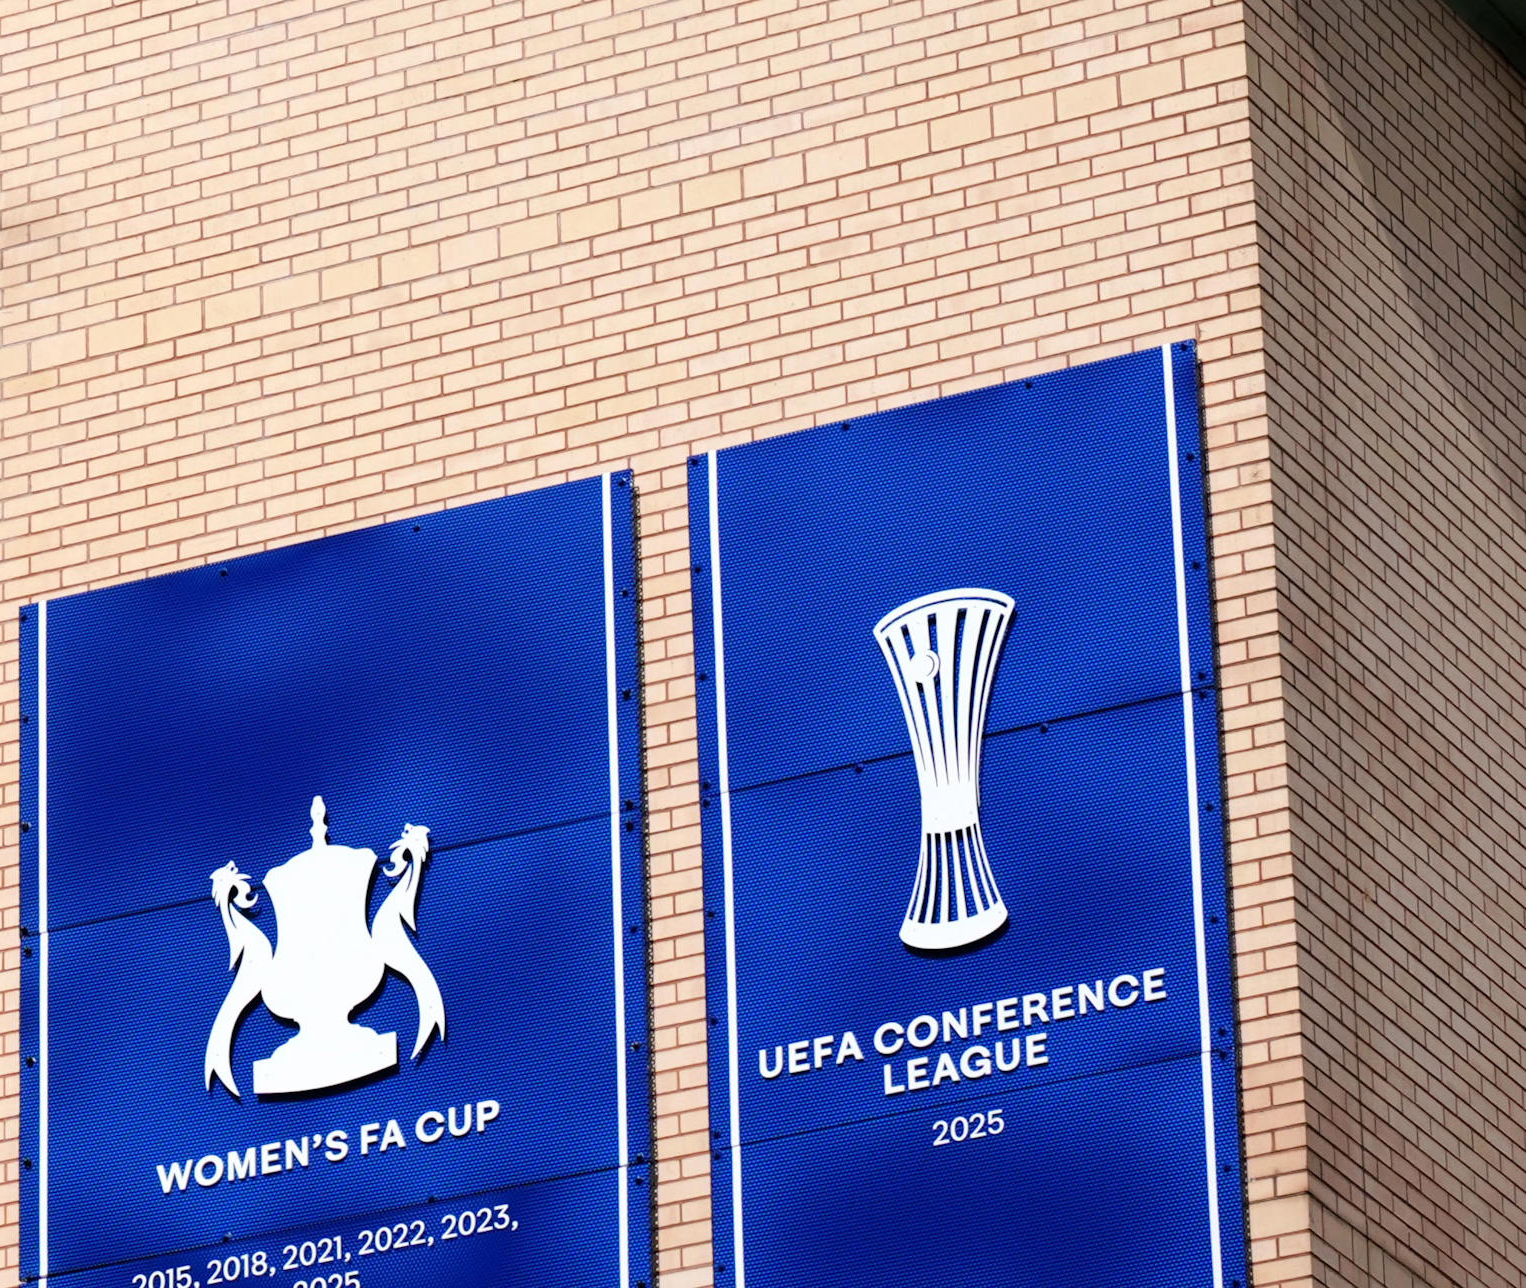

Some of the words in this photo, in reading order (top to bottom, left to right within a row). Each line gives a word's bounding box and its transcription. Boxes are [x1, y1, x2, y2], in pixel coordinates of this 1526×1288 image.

[758, 1032, 865, 1079] UEFA
[873, 967, 1168, 1055] CONFERENCE
[883, 1032, 1049, 1095] LEAGUE
[156, 1129, 349, 1194] WOMEN’S
[360, 1119, 407, 1155] FA
[415, 1099, 500, 1143] CUP
[932, 1108, 1005, 1147] 2025
[206, 1251, 277, 1285] 2018,
[282, 1235, 352, 1271] 2021,
[358, 1219, 435, 1256] 2022,
[441, 1203, 519, 1240] 2023,
[293, 1270, 360, 1288] 25
